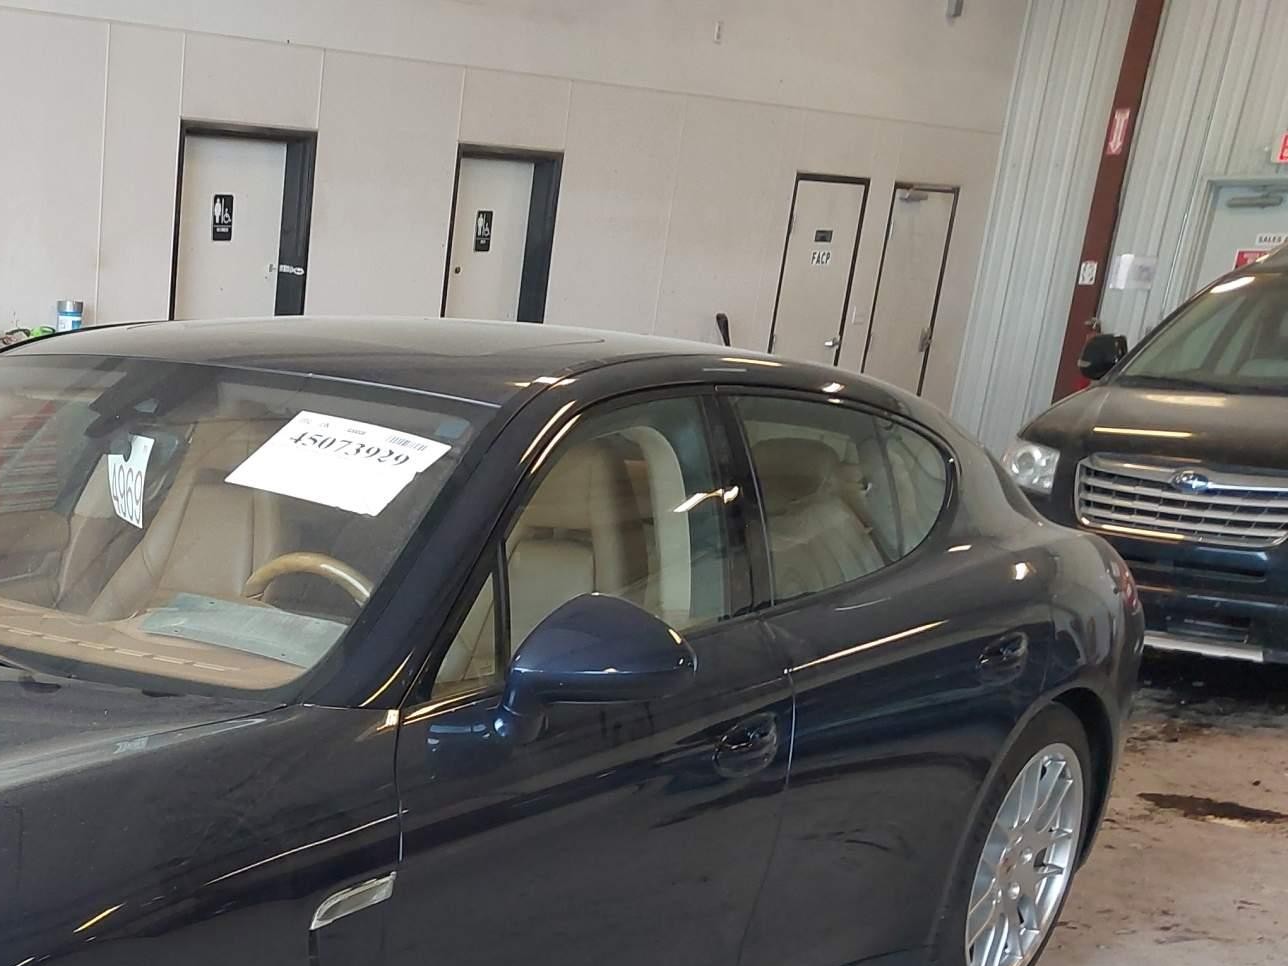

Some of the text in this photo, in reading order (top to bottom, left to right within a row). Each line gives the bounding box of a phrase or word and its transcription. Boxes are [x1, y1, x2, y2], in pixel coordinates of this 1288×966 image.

[811, 251, 831, 264] FACP
[289, 431, 410, 466] 45073929
[112, 464, 142, 524] 4969
